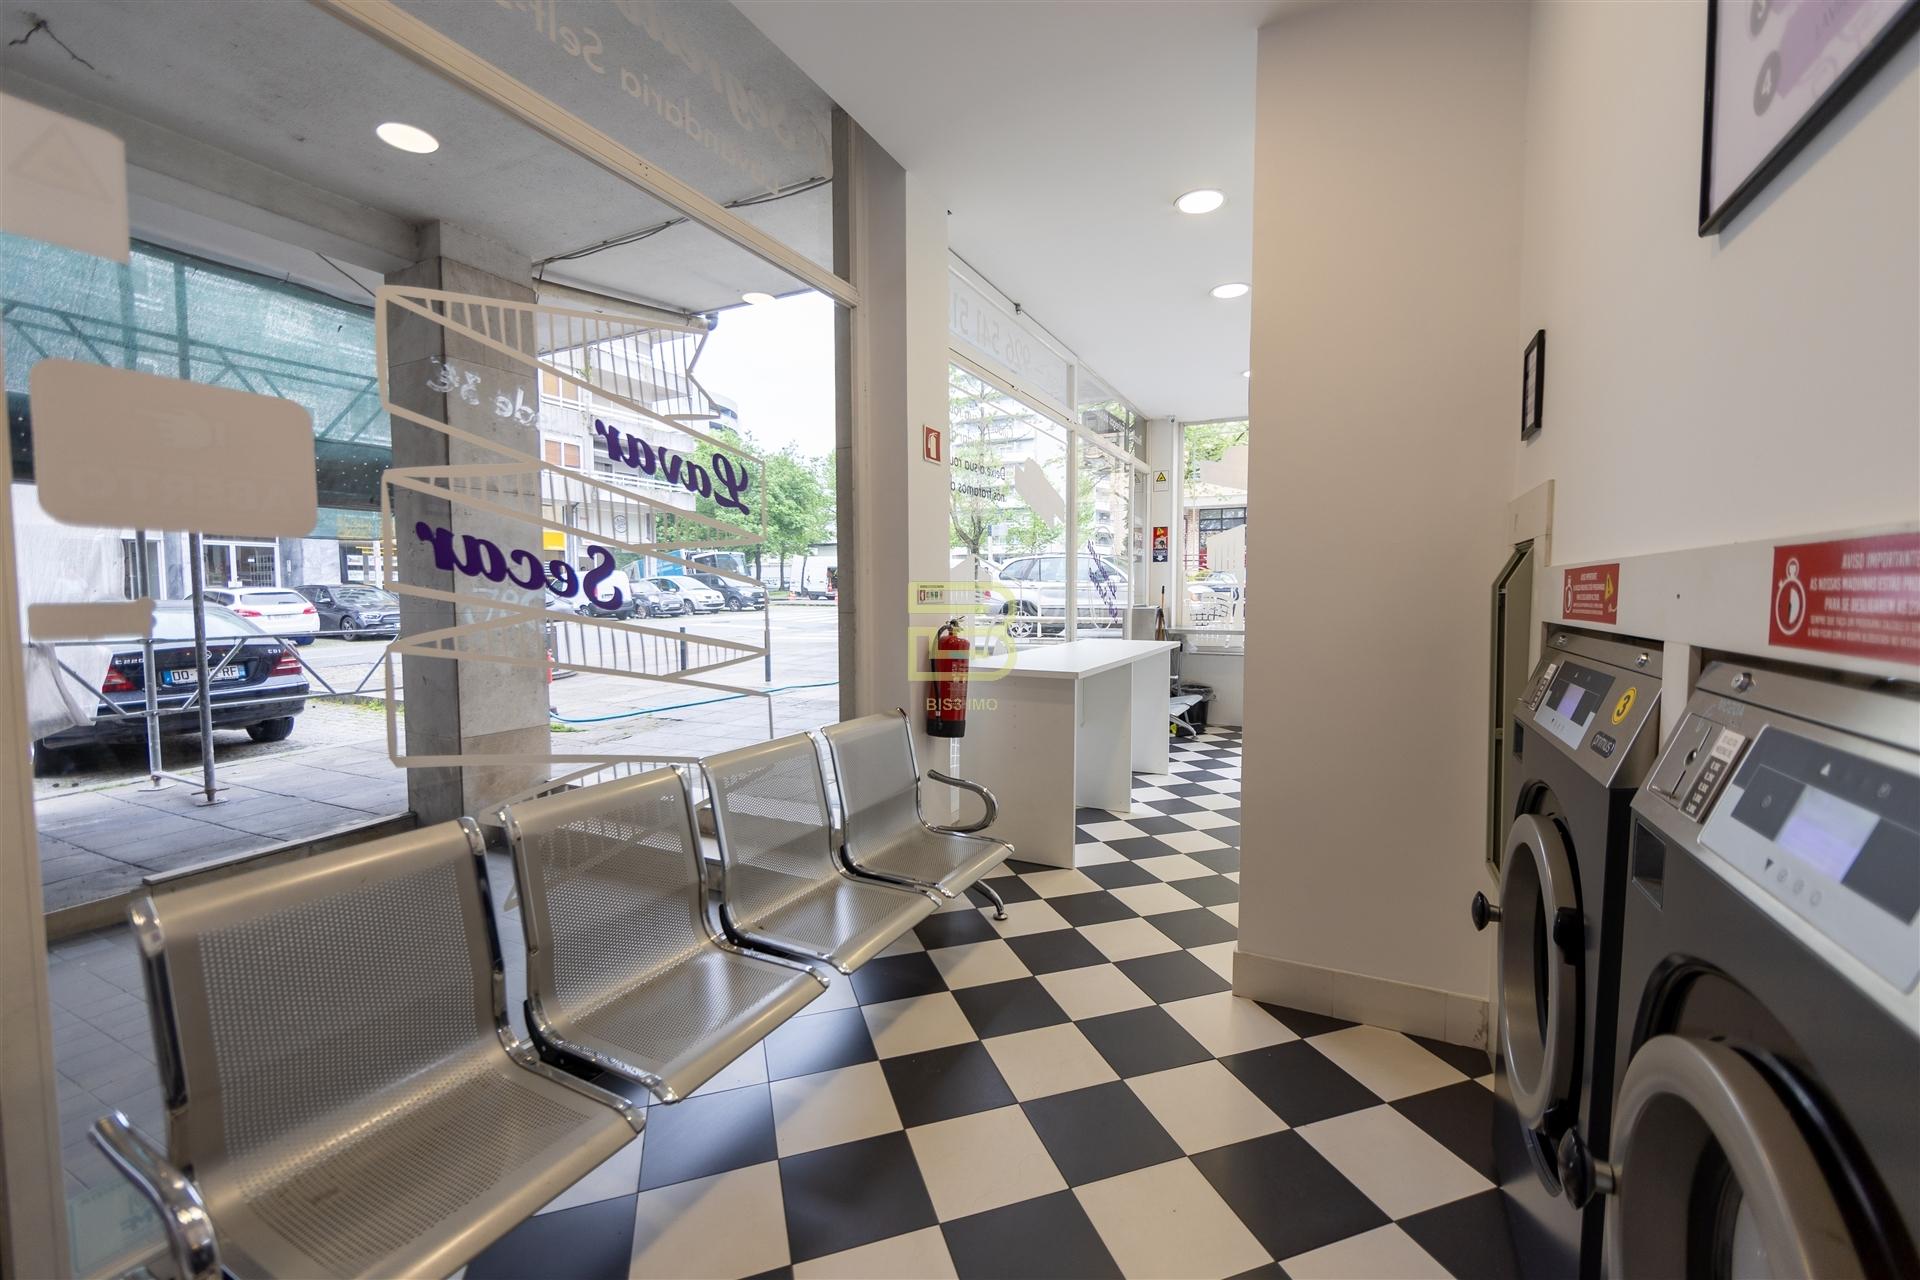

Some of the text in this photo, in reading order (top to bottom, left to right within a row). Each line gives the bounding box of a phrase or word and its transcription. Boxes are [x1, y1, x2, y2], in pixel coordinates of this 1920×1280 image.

[1761, 69, 1772, 95] 4
[1842, 552, 1865, 569] AVISO
[1616, 694, 1631, 717] 3
